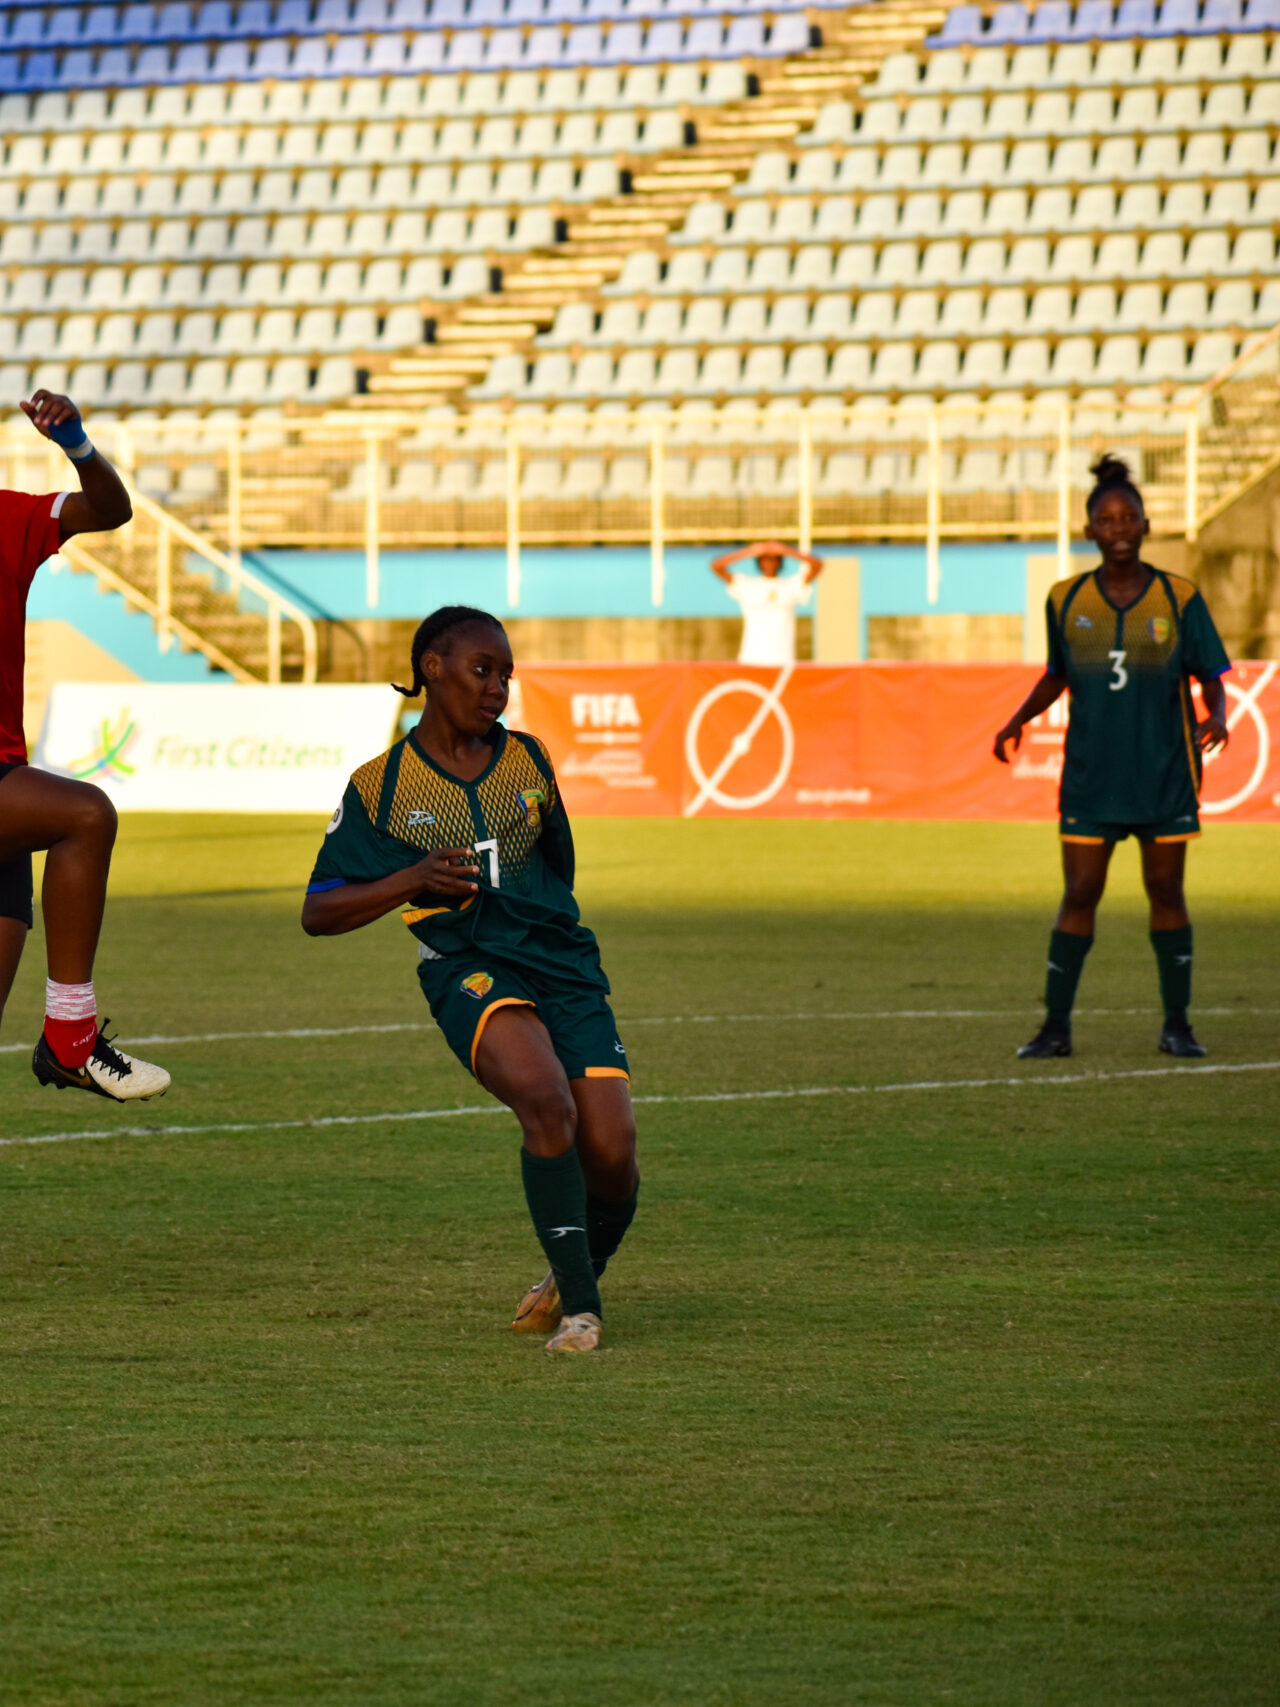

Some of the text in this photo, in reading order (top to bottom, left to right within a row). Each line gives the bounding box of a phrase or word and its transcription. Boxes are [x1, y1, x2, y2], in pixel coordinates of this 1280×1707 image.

[1108, 650, 1128, 691] 3
[571, 693, 641, 727] FIFA
[153, 735, 344, 768] First Citizens
[474, 838, 500, 888] 7
